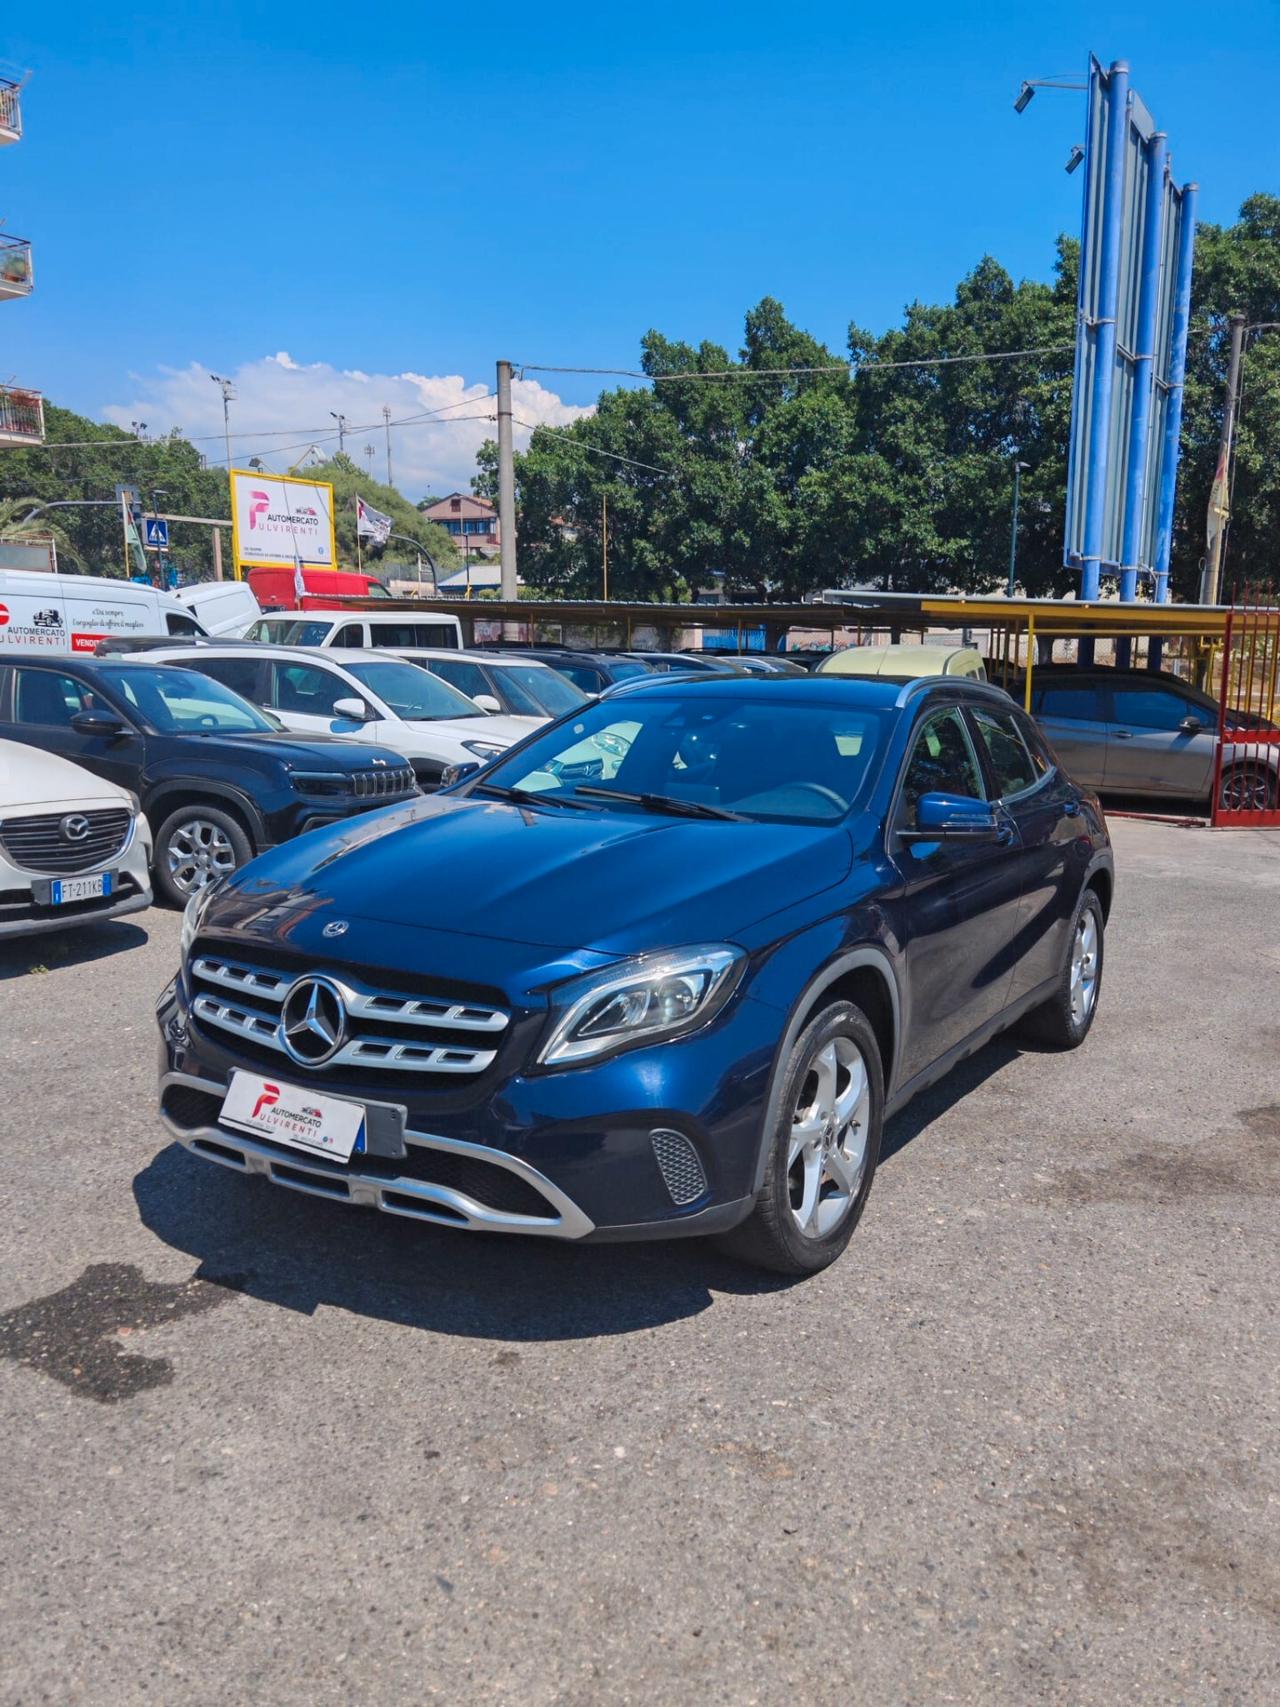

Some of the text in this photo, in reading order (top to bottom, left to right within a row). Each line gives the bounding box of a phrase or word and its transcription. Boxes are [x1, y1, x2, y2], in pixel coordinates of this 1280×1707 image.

[267, 514, 319, 526] AUTOMERCATO
[8, 627, 65, 637] AUTOMERCATO
[271, 1107, 322, 1128] AUTOMERCATO
